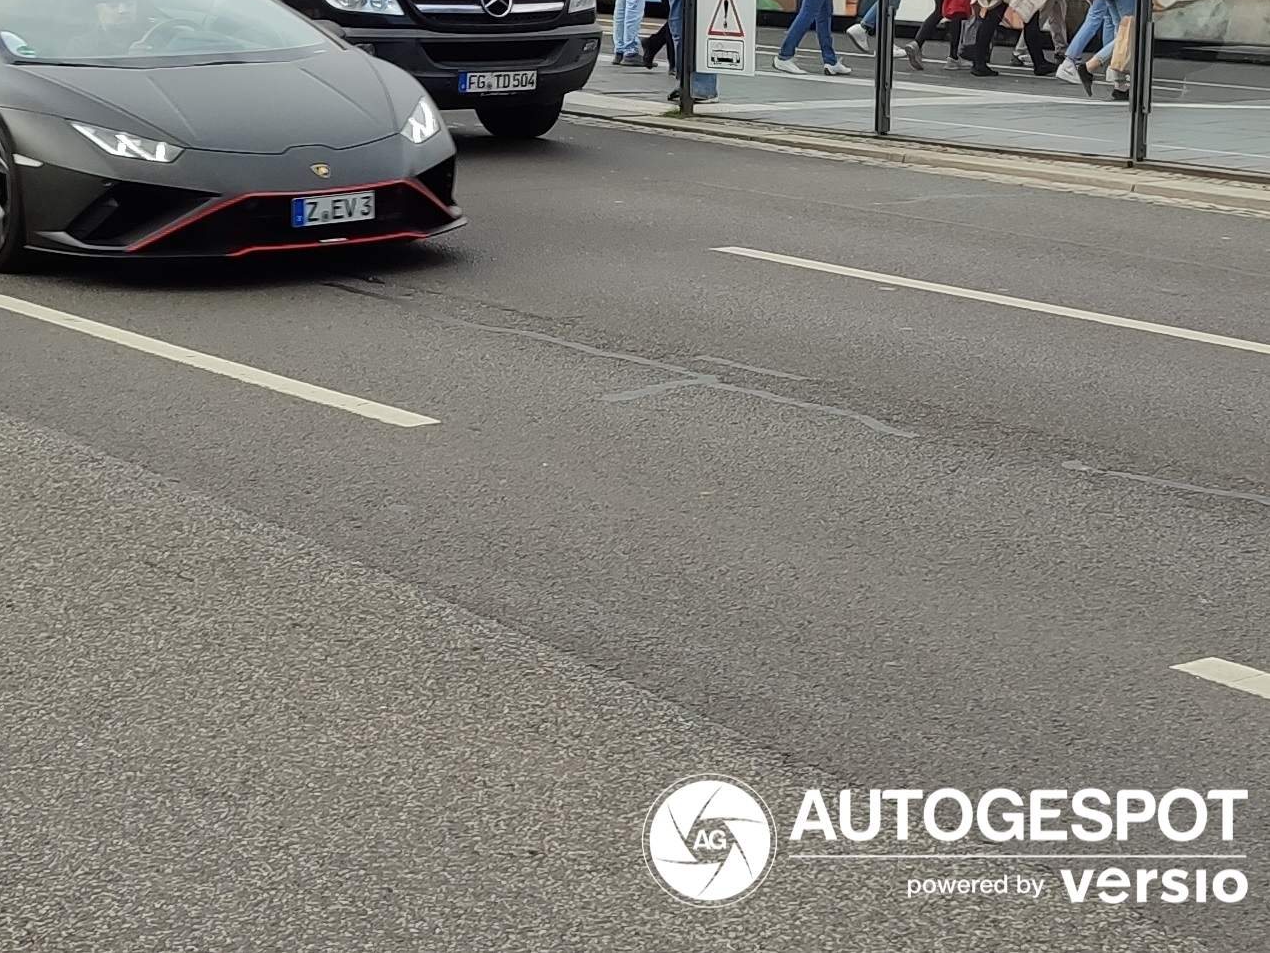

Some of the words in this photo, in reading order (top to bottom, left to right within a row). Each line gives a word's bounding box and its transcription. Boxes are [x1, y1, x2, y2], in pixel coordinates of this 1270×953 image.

[468, 74, 486, 90] FG
[494, 73, 511, 89] TD
[512, 72, 535, 88] 504
[306, 201, 319, 222] Z
[331, 198, 357, 220] EV
[360, 195, 372, 216] 3
